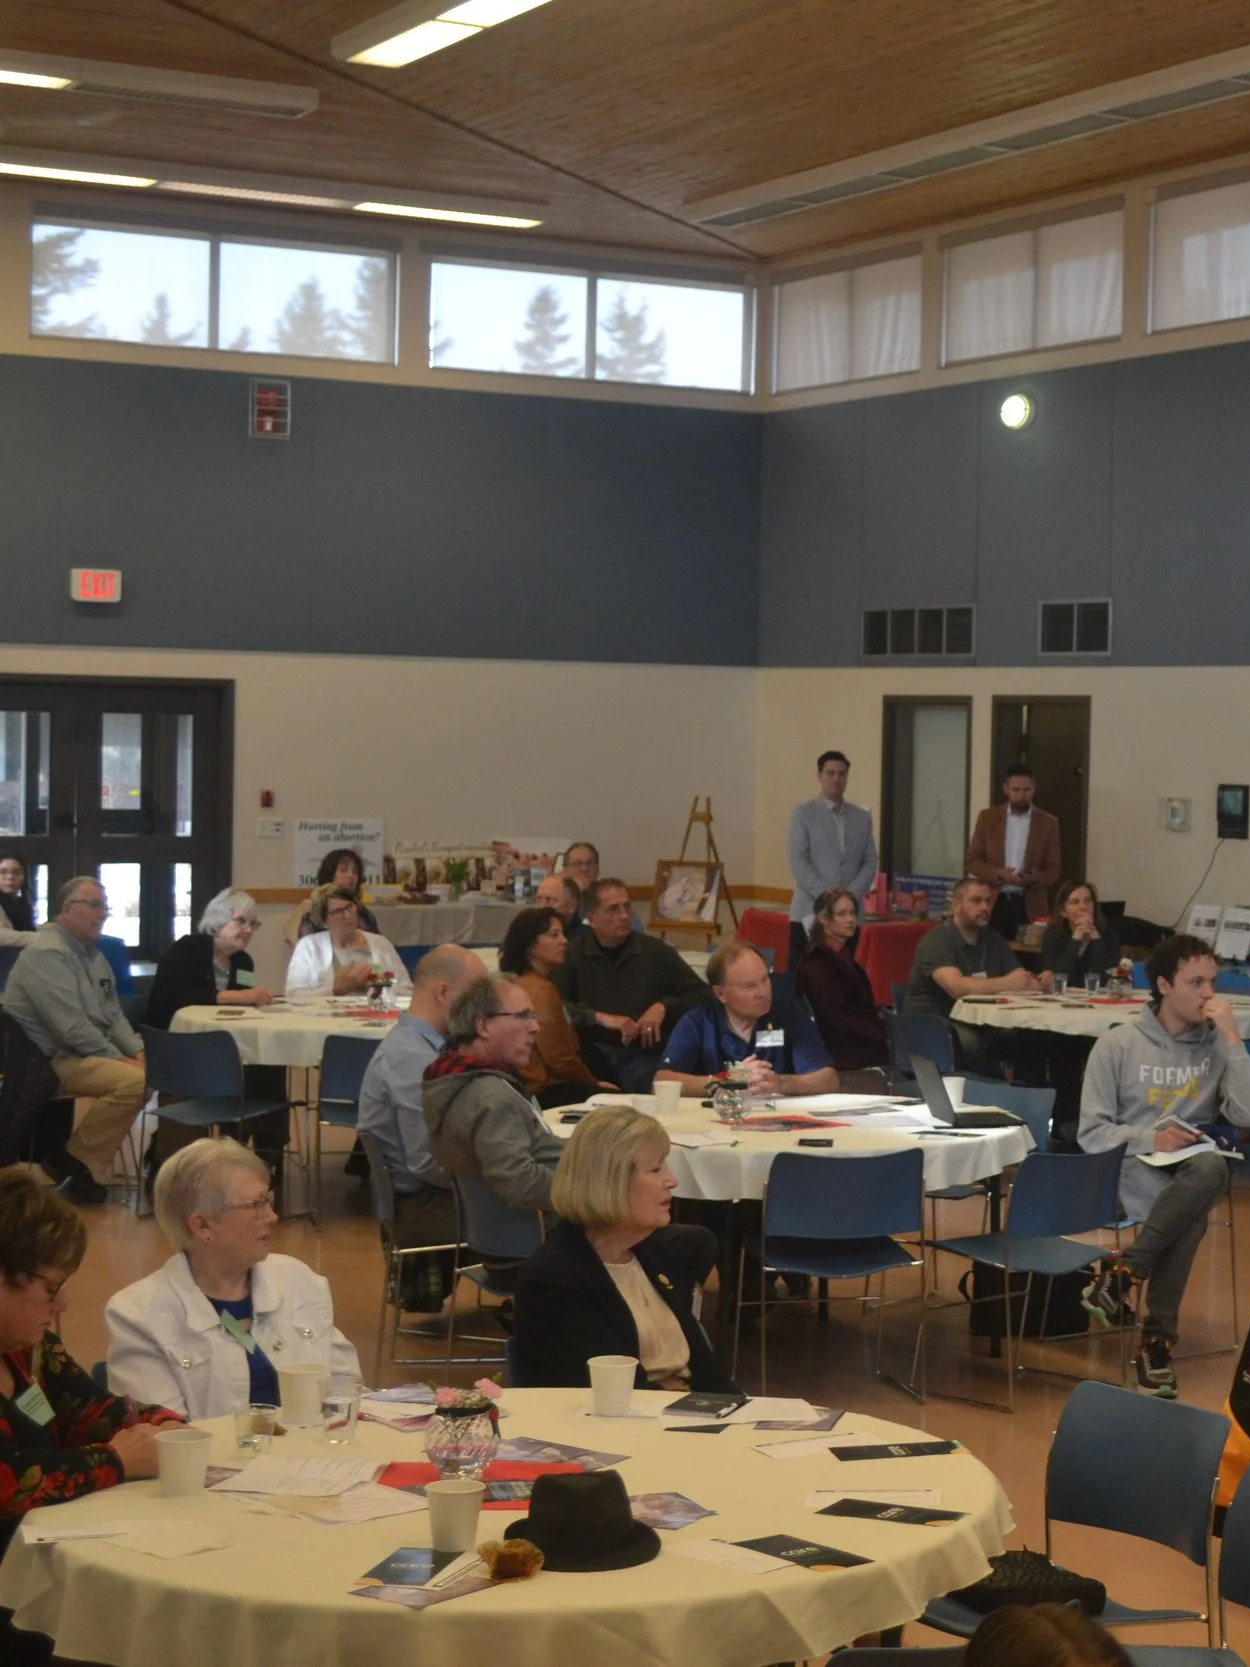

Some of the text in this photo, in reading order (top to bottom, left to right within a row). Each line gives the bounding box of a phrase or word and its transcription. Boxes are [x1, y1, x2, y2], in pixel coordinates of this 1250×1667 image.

[81, 572, 114, 599] EXIT
[299, 821, 363, 832] Hurting from
[318, 831, 380, 841] an abortion?
